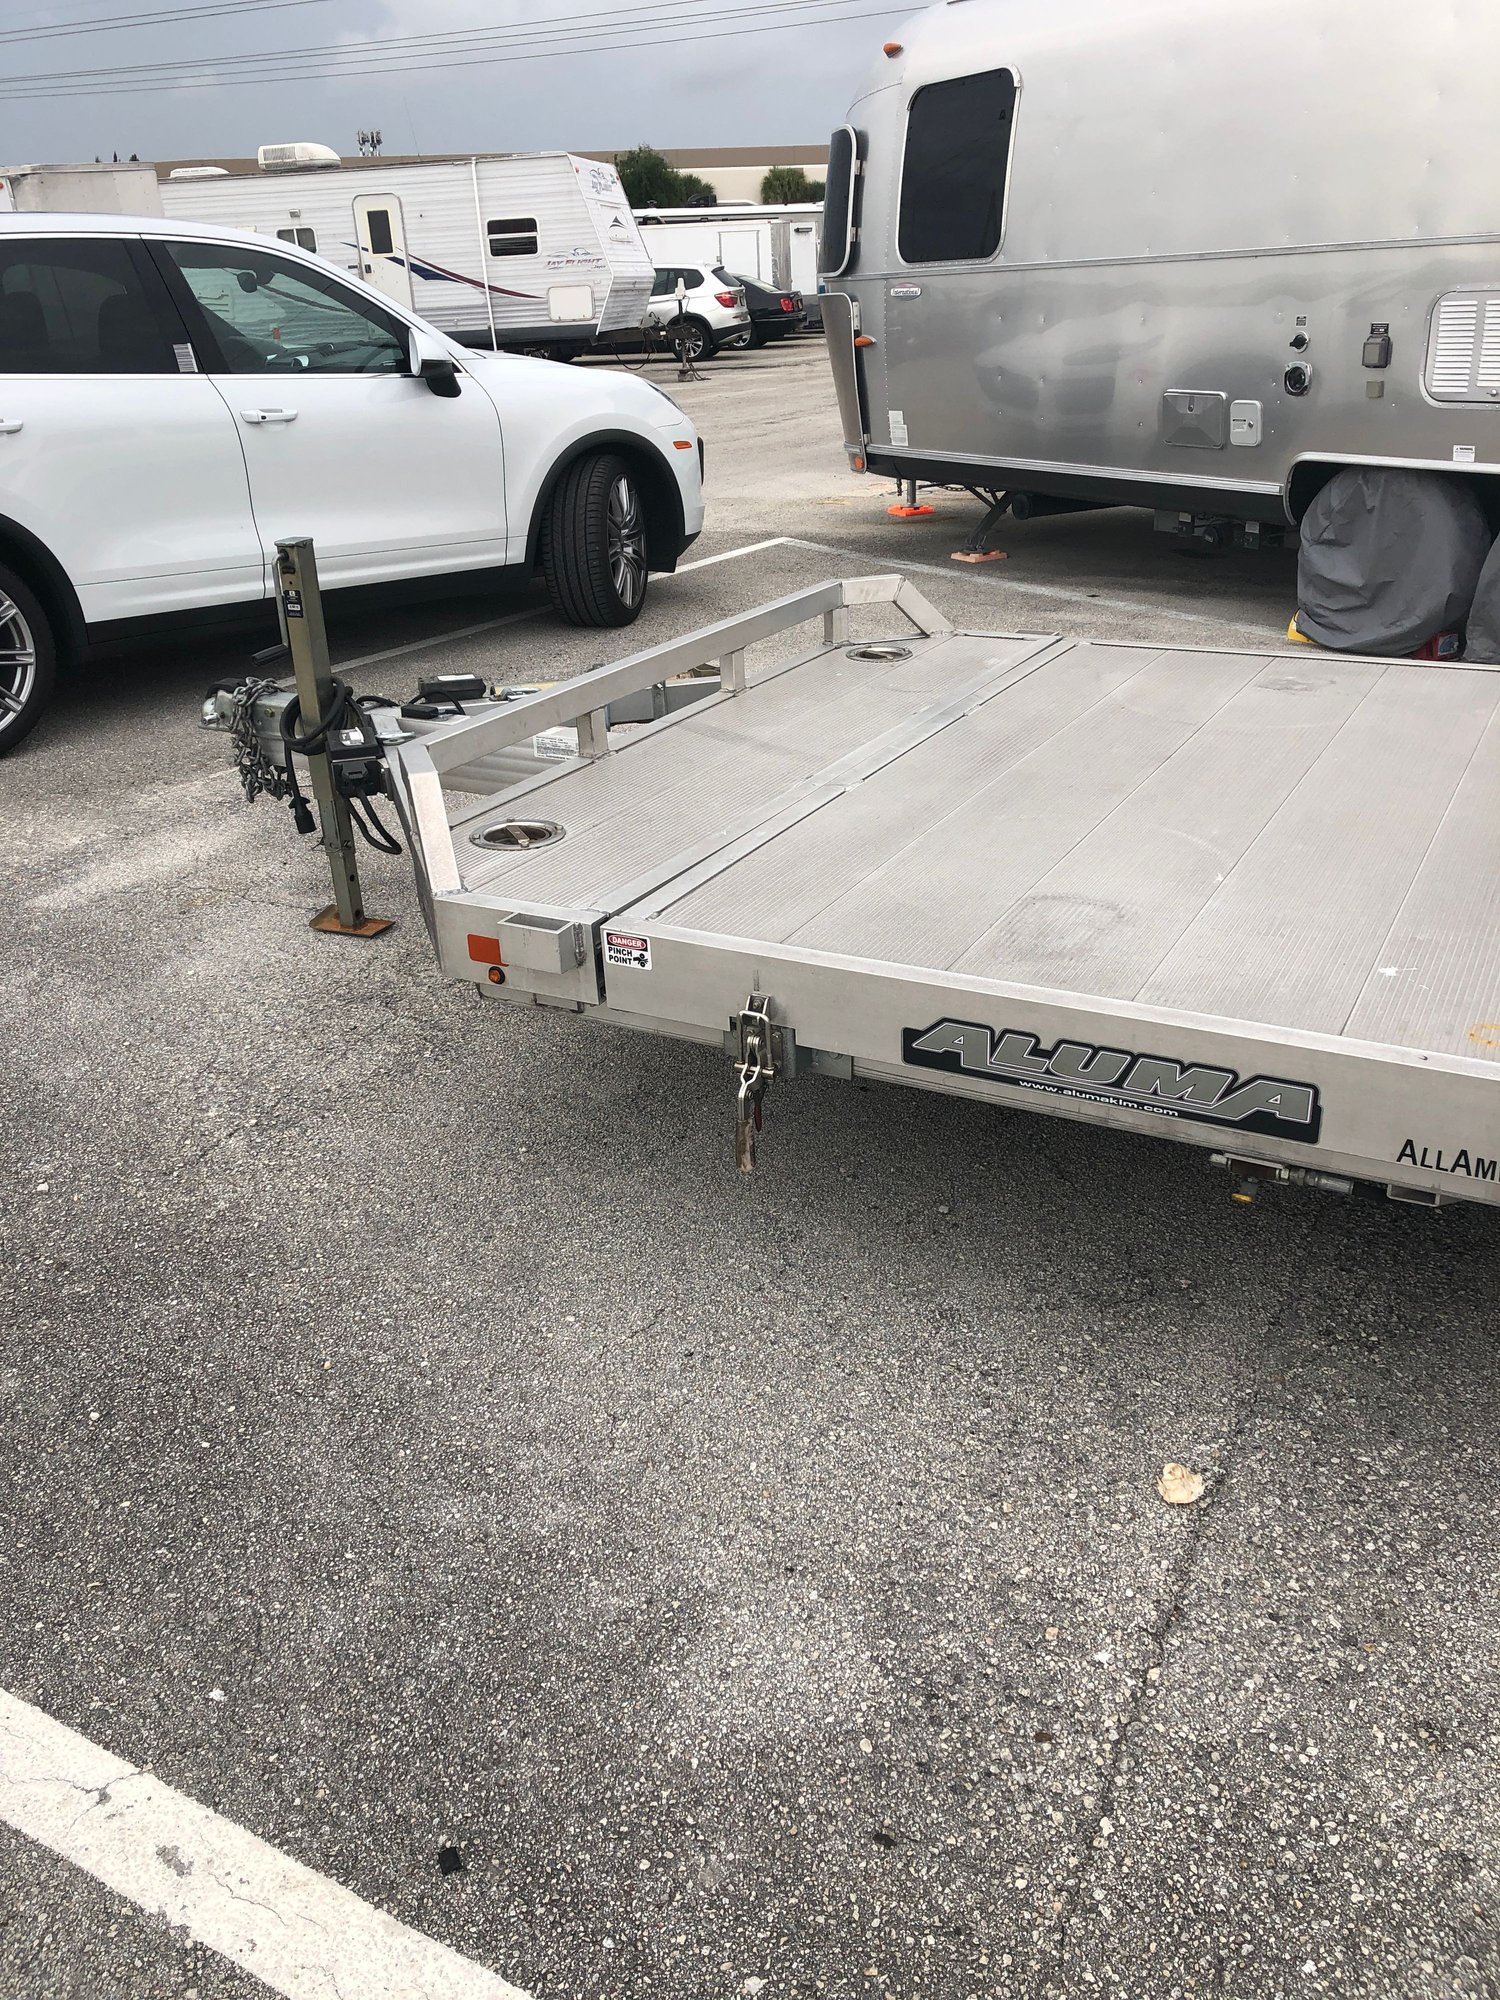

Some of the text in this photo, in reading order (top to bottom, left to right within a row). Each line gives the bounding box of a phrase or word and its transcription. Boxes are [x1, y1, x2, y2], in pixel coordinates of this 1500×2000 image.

[608, 946, 633, 957] PINCH
[612, 936, 642, 948] DANGER
[609, 954, 633, 965] POINT
[911, 1022, 1314, 1123] ALUMA
[1018, 1080, 1179, 1117] www.alumaklm.com
[1396, 1138, 1500, 1183] ALLAM
